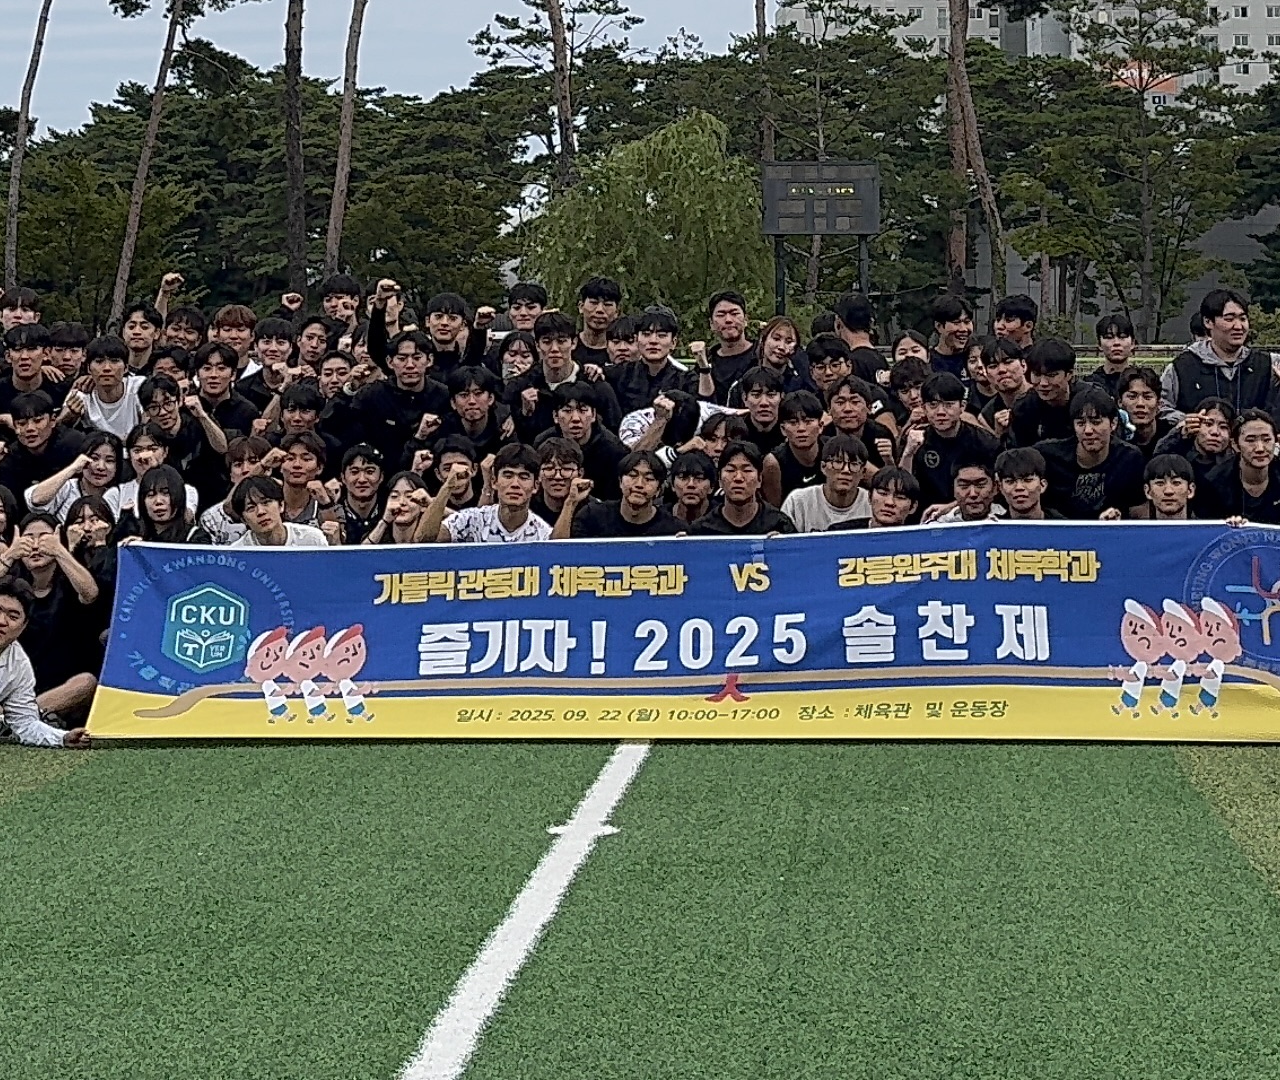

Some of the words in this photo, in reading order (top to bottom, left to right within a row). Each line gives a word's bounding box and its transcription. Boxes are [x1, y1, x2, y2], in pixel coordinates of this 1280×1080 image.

[163, 554, 247, 573] KWANDONG
[548, 564, 688, 598] 체육교육과
[728, 562, 771, 593] VS
[838, 549, 977, 587] 강릉원주대
[985, 548, 1101, 583] 체육학과
[181, 604, 235, 625] CKU
[634, 612, 808, 672] 2025
[563, 709, 589, 721] 09.
[597, 710, 621, 721] 22
[627, 708, 660, 722] (월)
[854, 702, 912, 719] 체육관
[925, 701, 943, 718] 및
[950, 700, 1009, 718] 운동장
